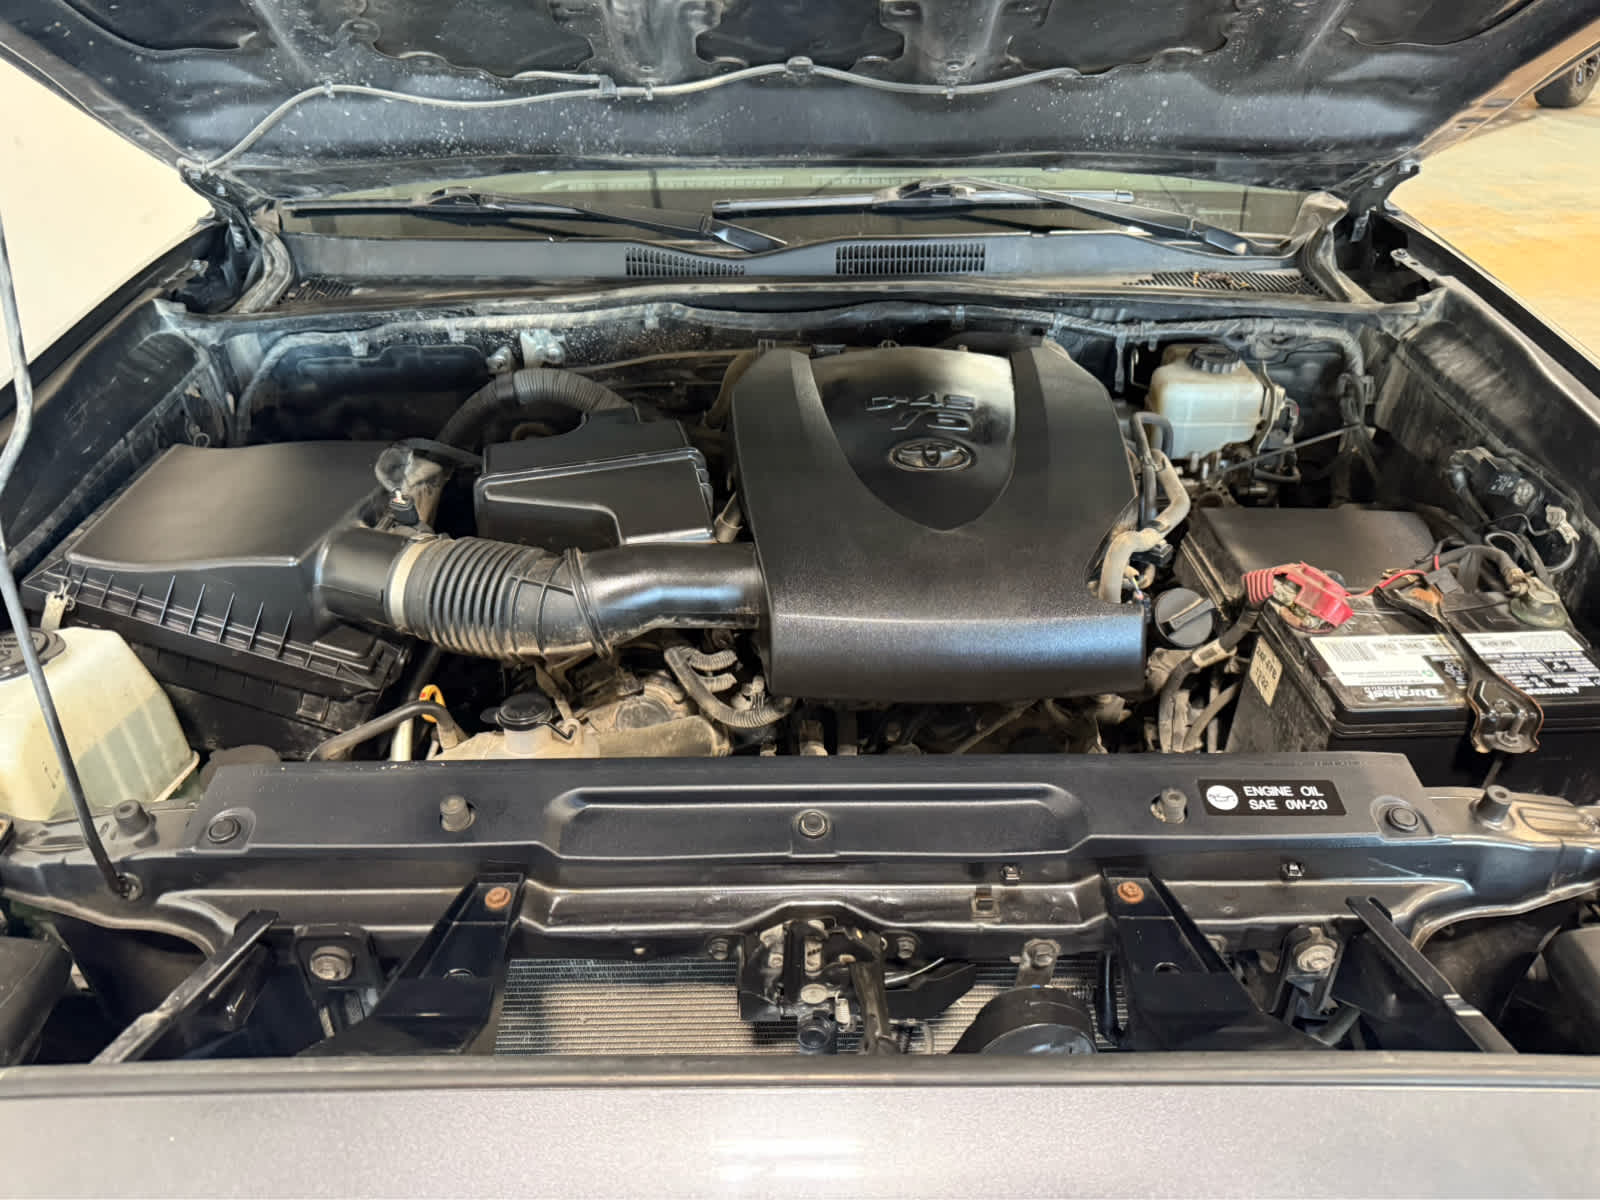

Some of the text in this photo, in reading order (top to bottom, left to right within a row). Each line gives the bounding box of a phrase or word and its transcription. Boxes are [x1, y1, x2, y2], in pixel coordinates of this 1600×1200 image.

[1366, 686, 1445, 700] Duralast
[1243, 786, 1324, 797] ENGINE OIL
[1248, 799, 1328, 810] SAE 0W-20
